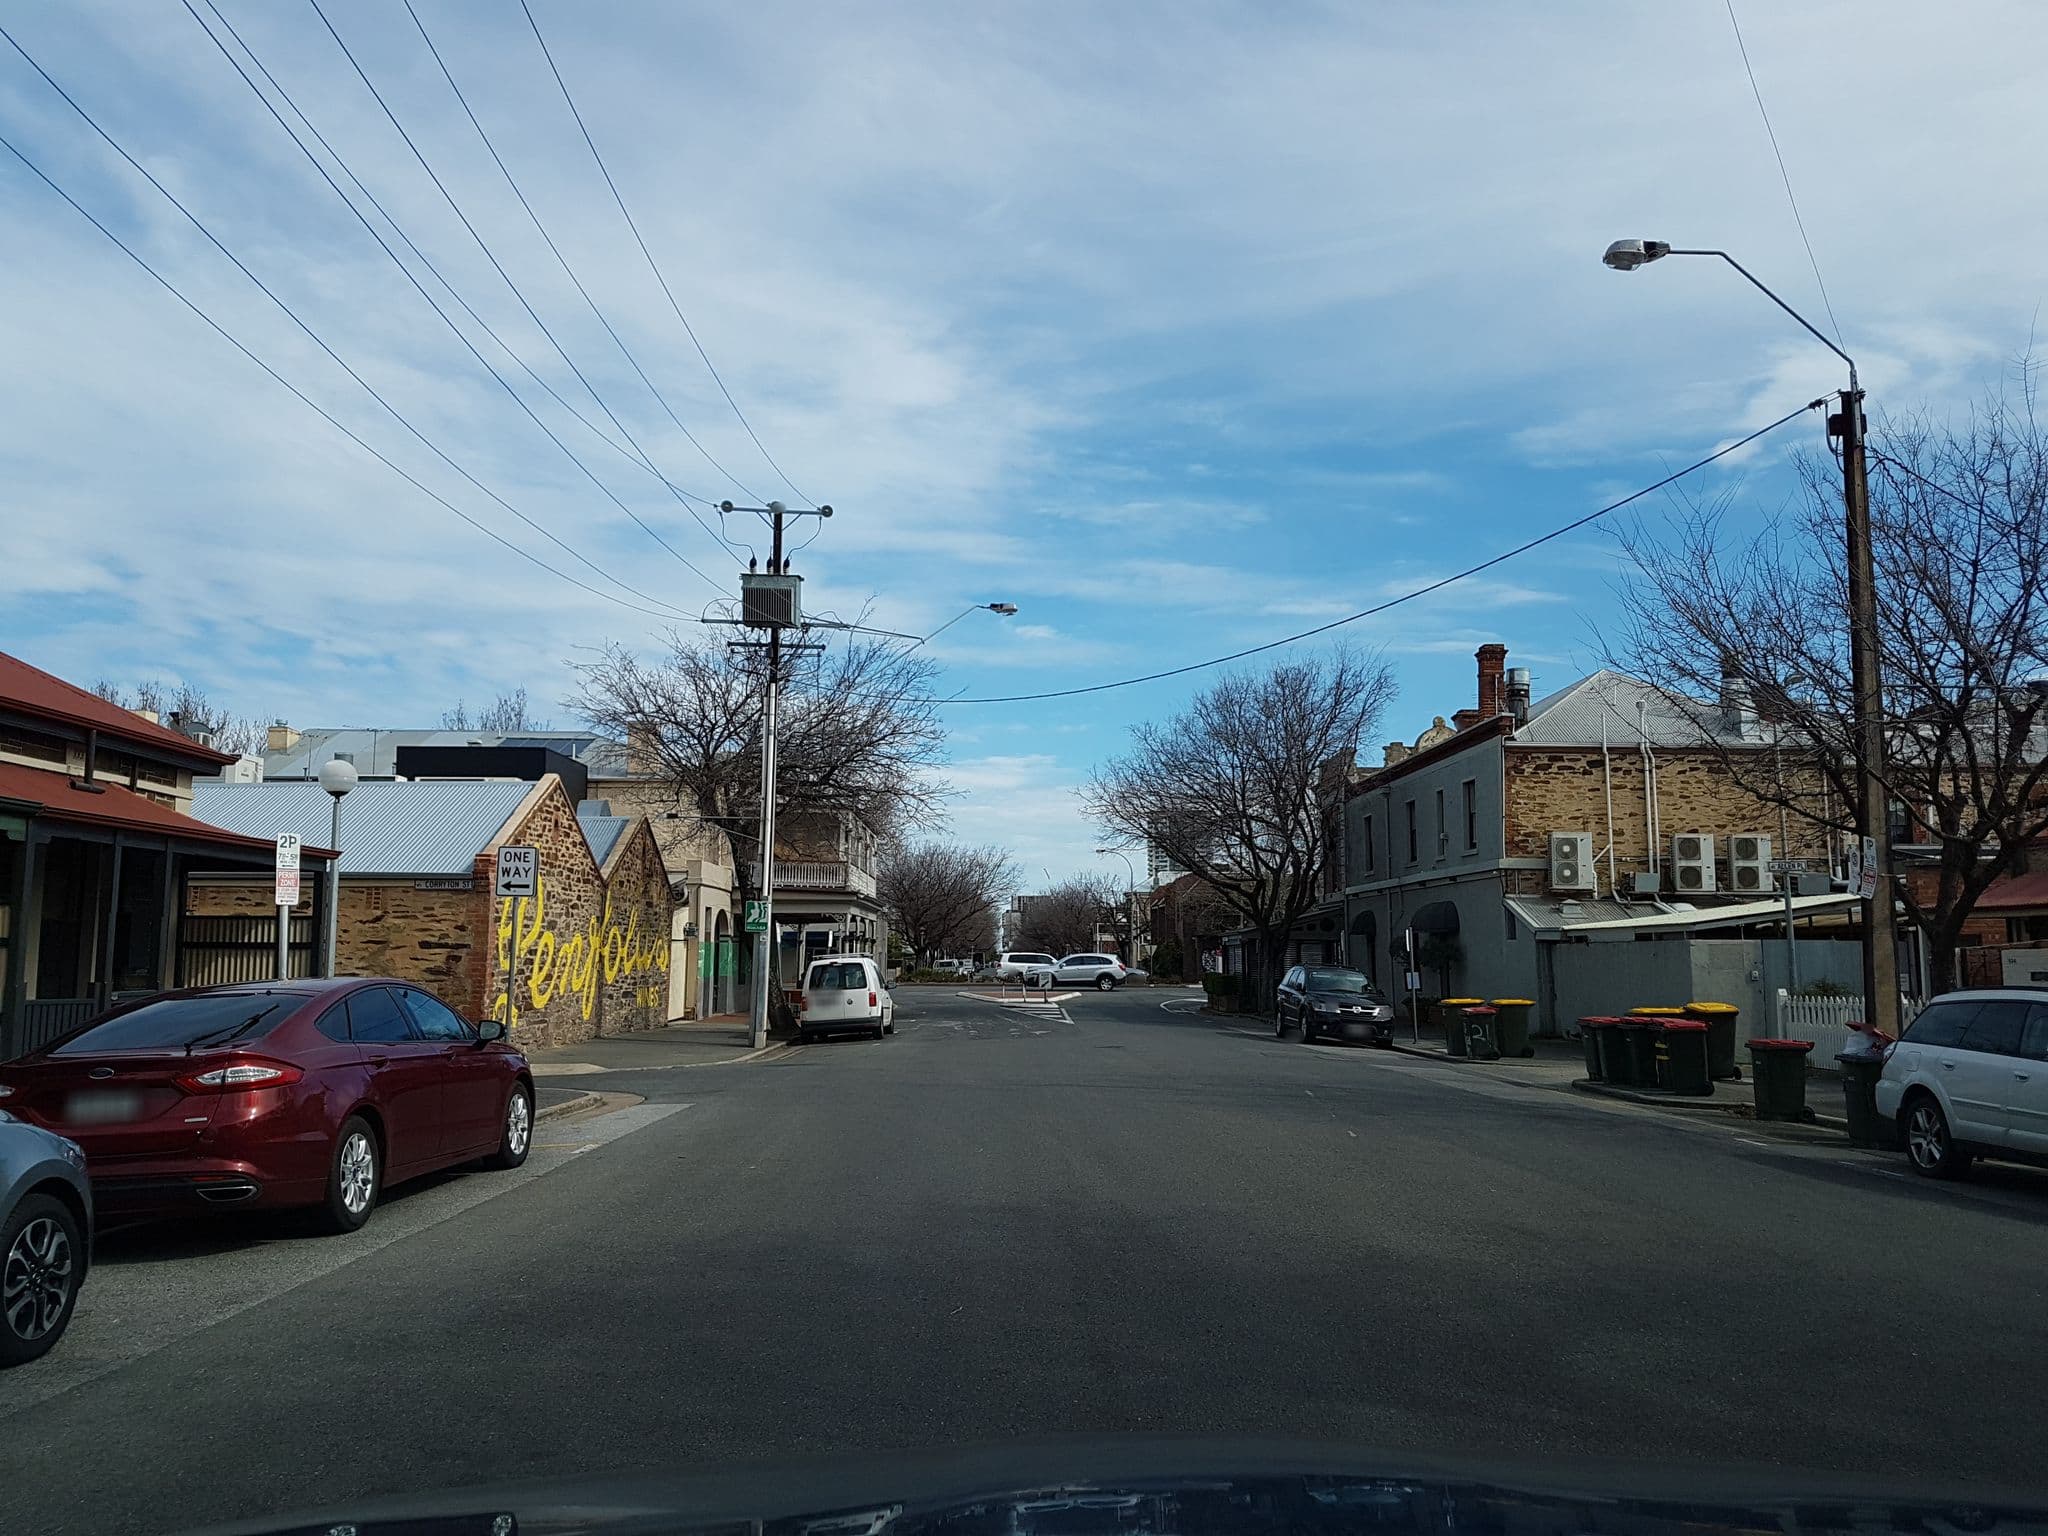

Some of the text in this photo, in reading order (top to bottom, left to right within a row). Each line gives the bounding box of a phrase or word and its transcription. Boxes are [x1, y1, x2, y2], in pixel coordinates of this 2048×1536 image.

[279, 835, 297, 849] 2P
[504, 851, 531, 863] ONE
[501, 866, 532, 878] WAY
[462, 880, 472, 889] ST
[636, 986, 659, 1008] WINES
